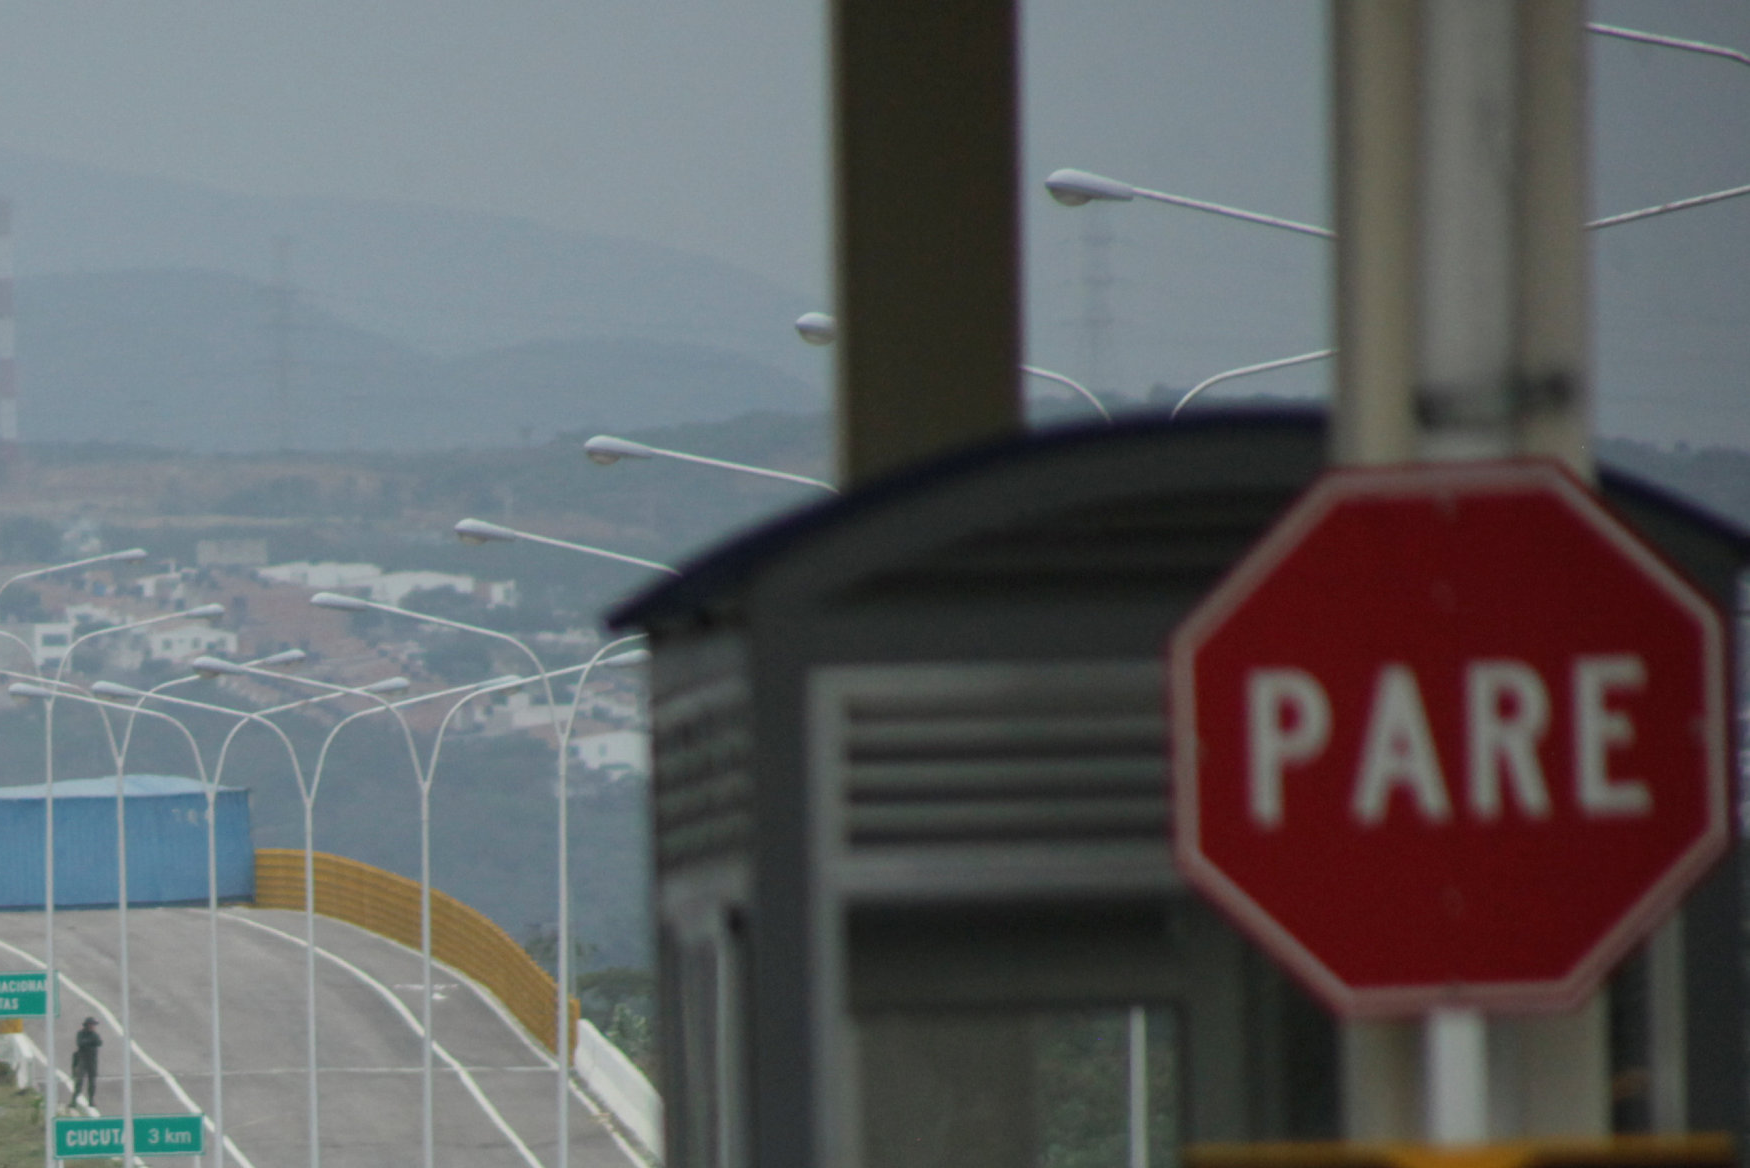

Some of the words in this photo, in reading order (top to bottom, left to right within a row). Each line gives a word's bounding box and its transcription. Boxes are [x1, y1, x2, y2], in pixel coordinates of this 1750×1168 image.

[1245, 654, 1651, 830] PARE
[148, 1129, 160, 1144] 3
[165, 1128, 192, 1143] km
